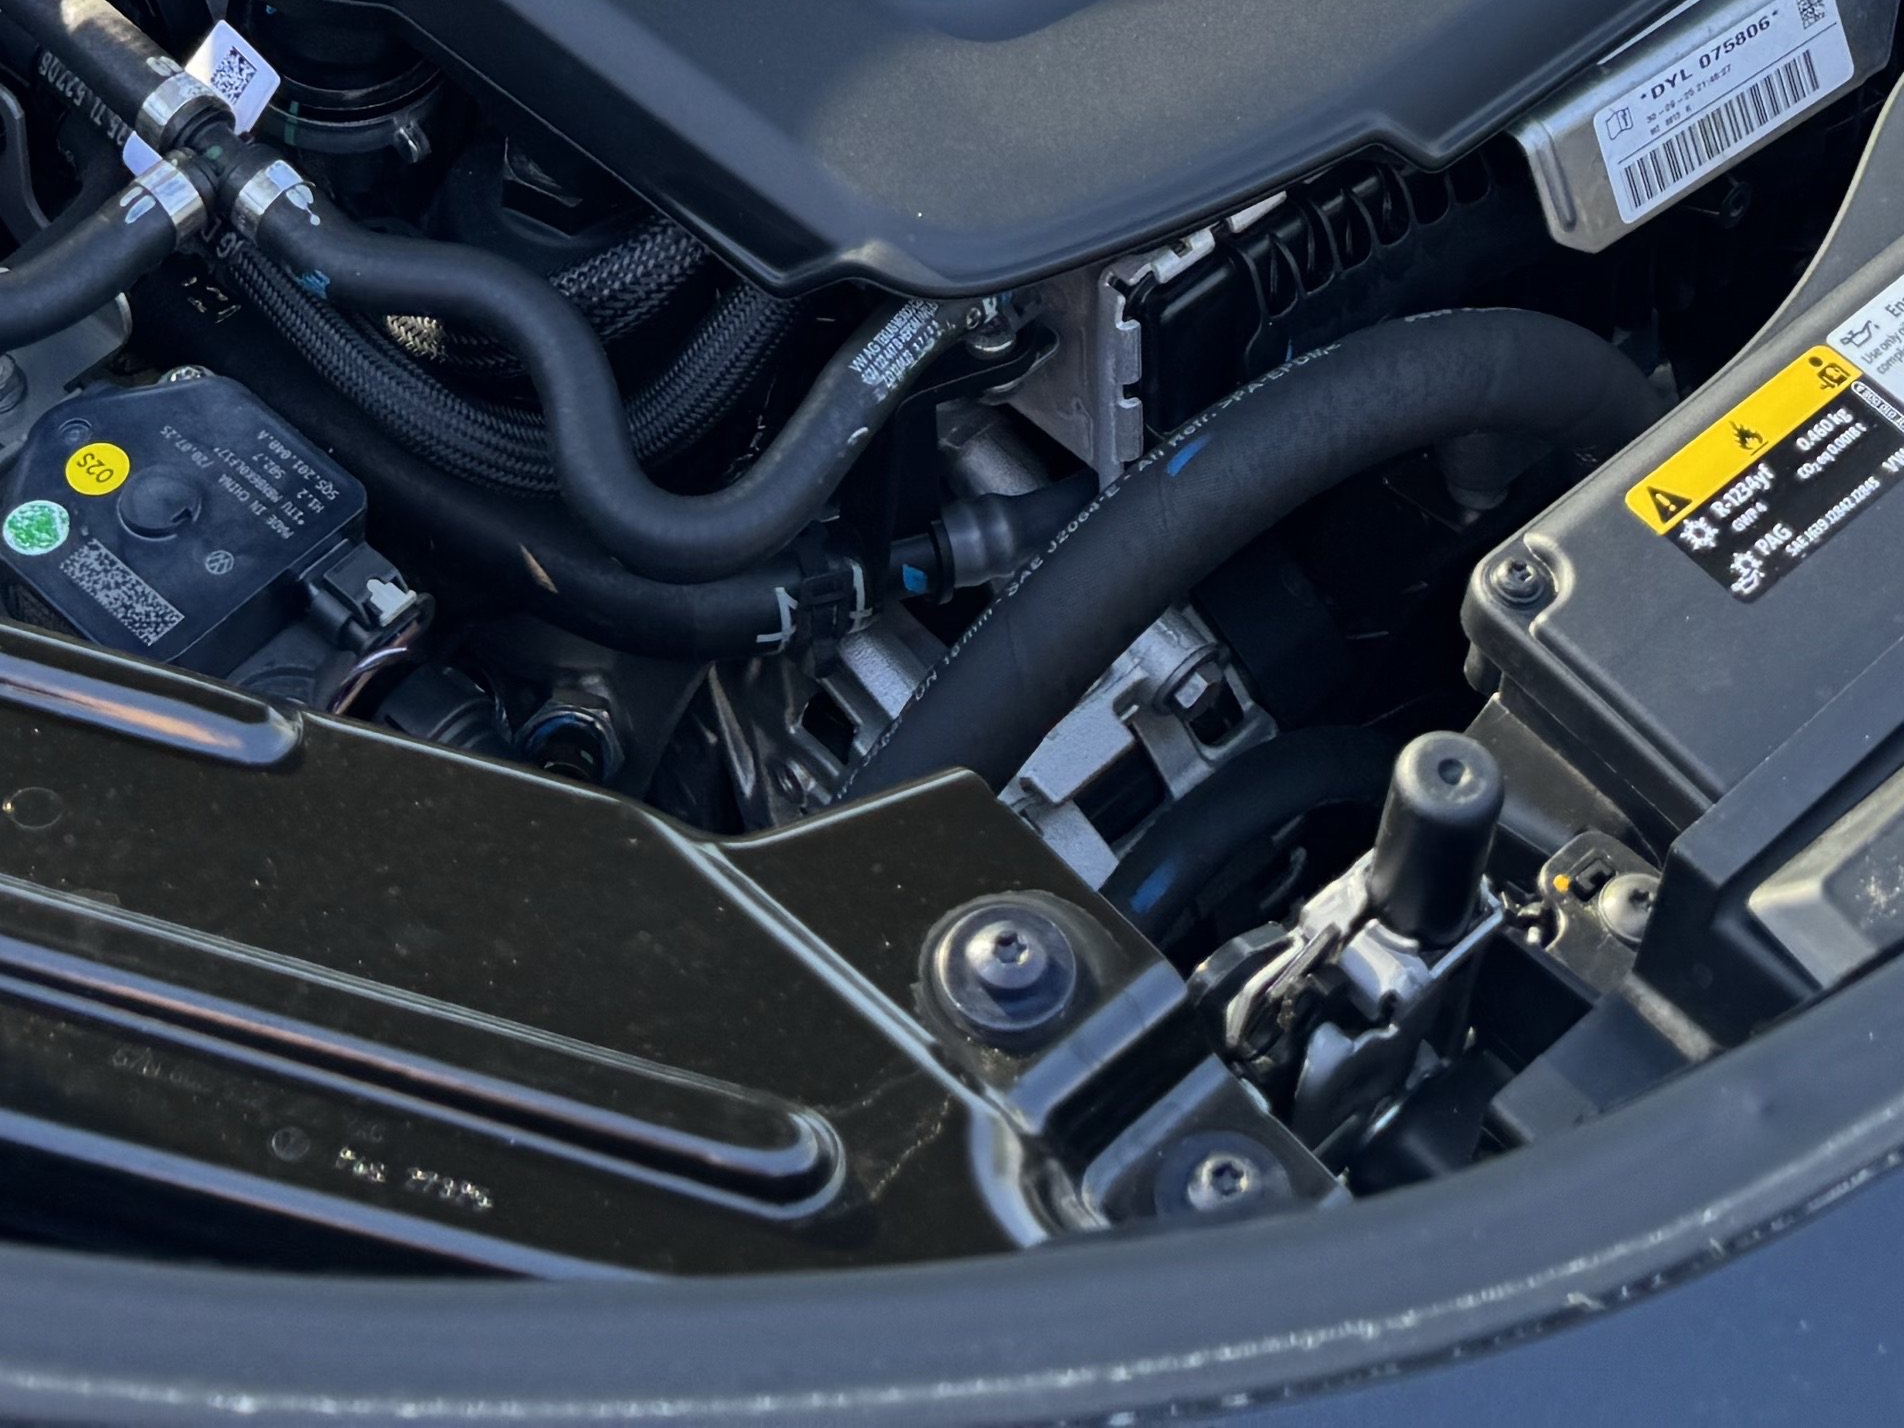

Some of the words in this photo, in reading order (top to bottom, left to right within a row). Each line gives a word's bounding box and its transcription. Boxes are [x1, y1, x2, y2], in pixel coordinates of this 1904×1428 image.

[1860, 347, 1882, 364] Use
[1879, 332, 1902, 351] only
[1710, 463, 1773, 517] R-1234yf
[1796, 418, 1834, 450] 0.460
[1826, 407, 1853, 425] kg
[218, 473, 250, 501] CHINA
[1731, 507, 1757, 531] GWP
[1755, 501, 1767, 512] 4
[1816, 450, 1835, 464] eq
[249, 499, 267, 515] IN
[265, 514, 293, 538] MADE
[1754, 523, 1792, 555] PAG
[1785, 535, 1808, 556] SAE
[1004, 553, 1045, 597] SAE
